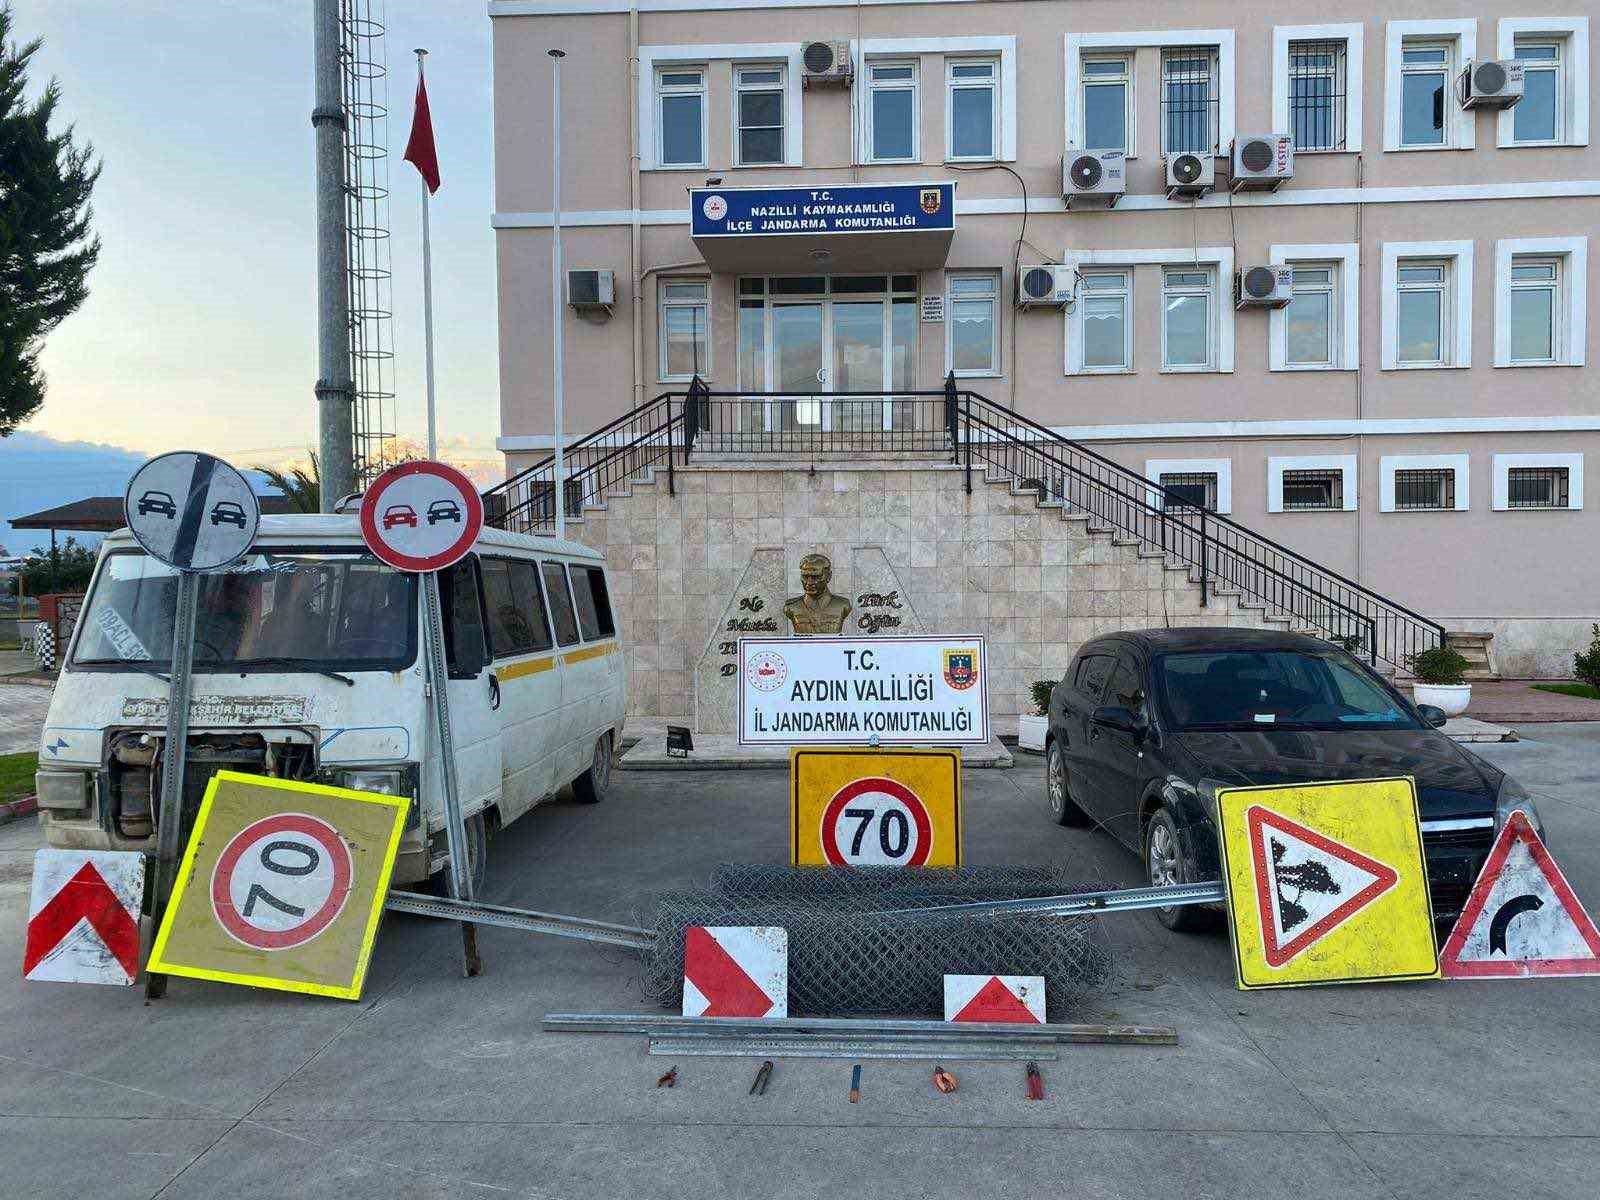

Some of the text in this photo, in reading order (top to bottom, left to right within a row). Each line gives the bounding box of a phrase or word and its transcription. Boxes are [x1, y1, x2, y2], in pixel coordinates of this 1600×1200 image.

[810, 191, 833, 201] T.C.
[751, 203, 895, 217] NAZİLLİ KAYMAKAMLIĞI
[726, 214, 916, 233] İLÇE JANDARMA KOMUTANLIĞI
[844, 649, 880, 671] T.C.
[790, 679, 848, 702] AYDIN
[854, 674, 934, 702] VALİLİĞİ
[754, 706, 972, 733] İL JANDARMA KOMUTANLIĞI
[843, 807, 910, 859] 70
[242, 840, 320, 918] 70
